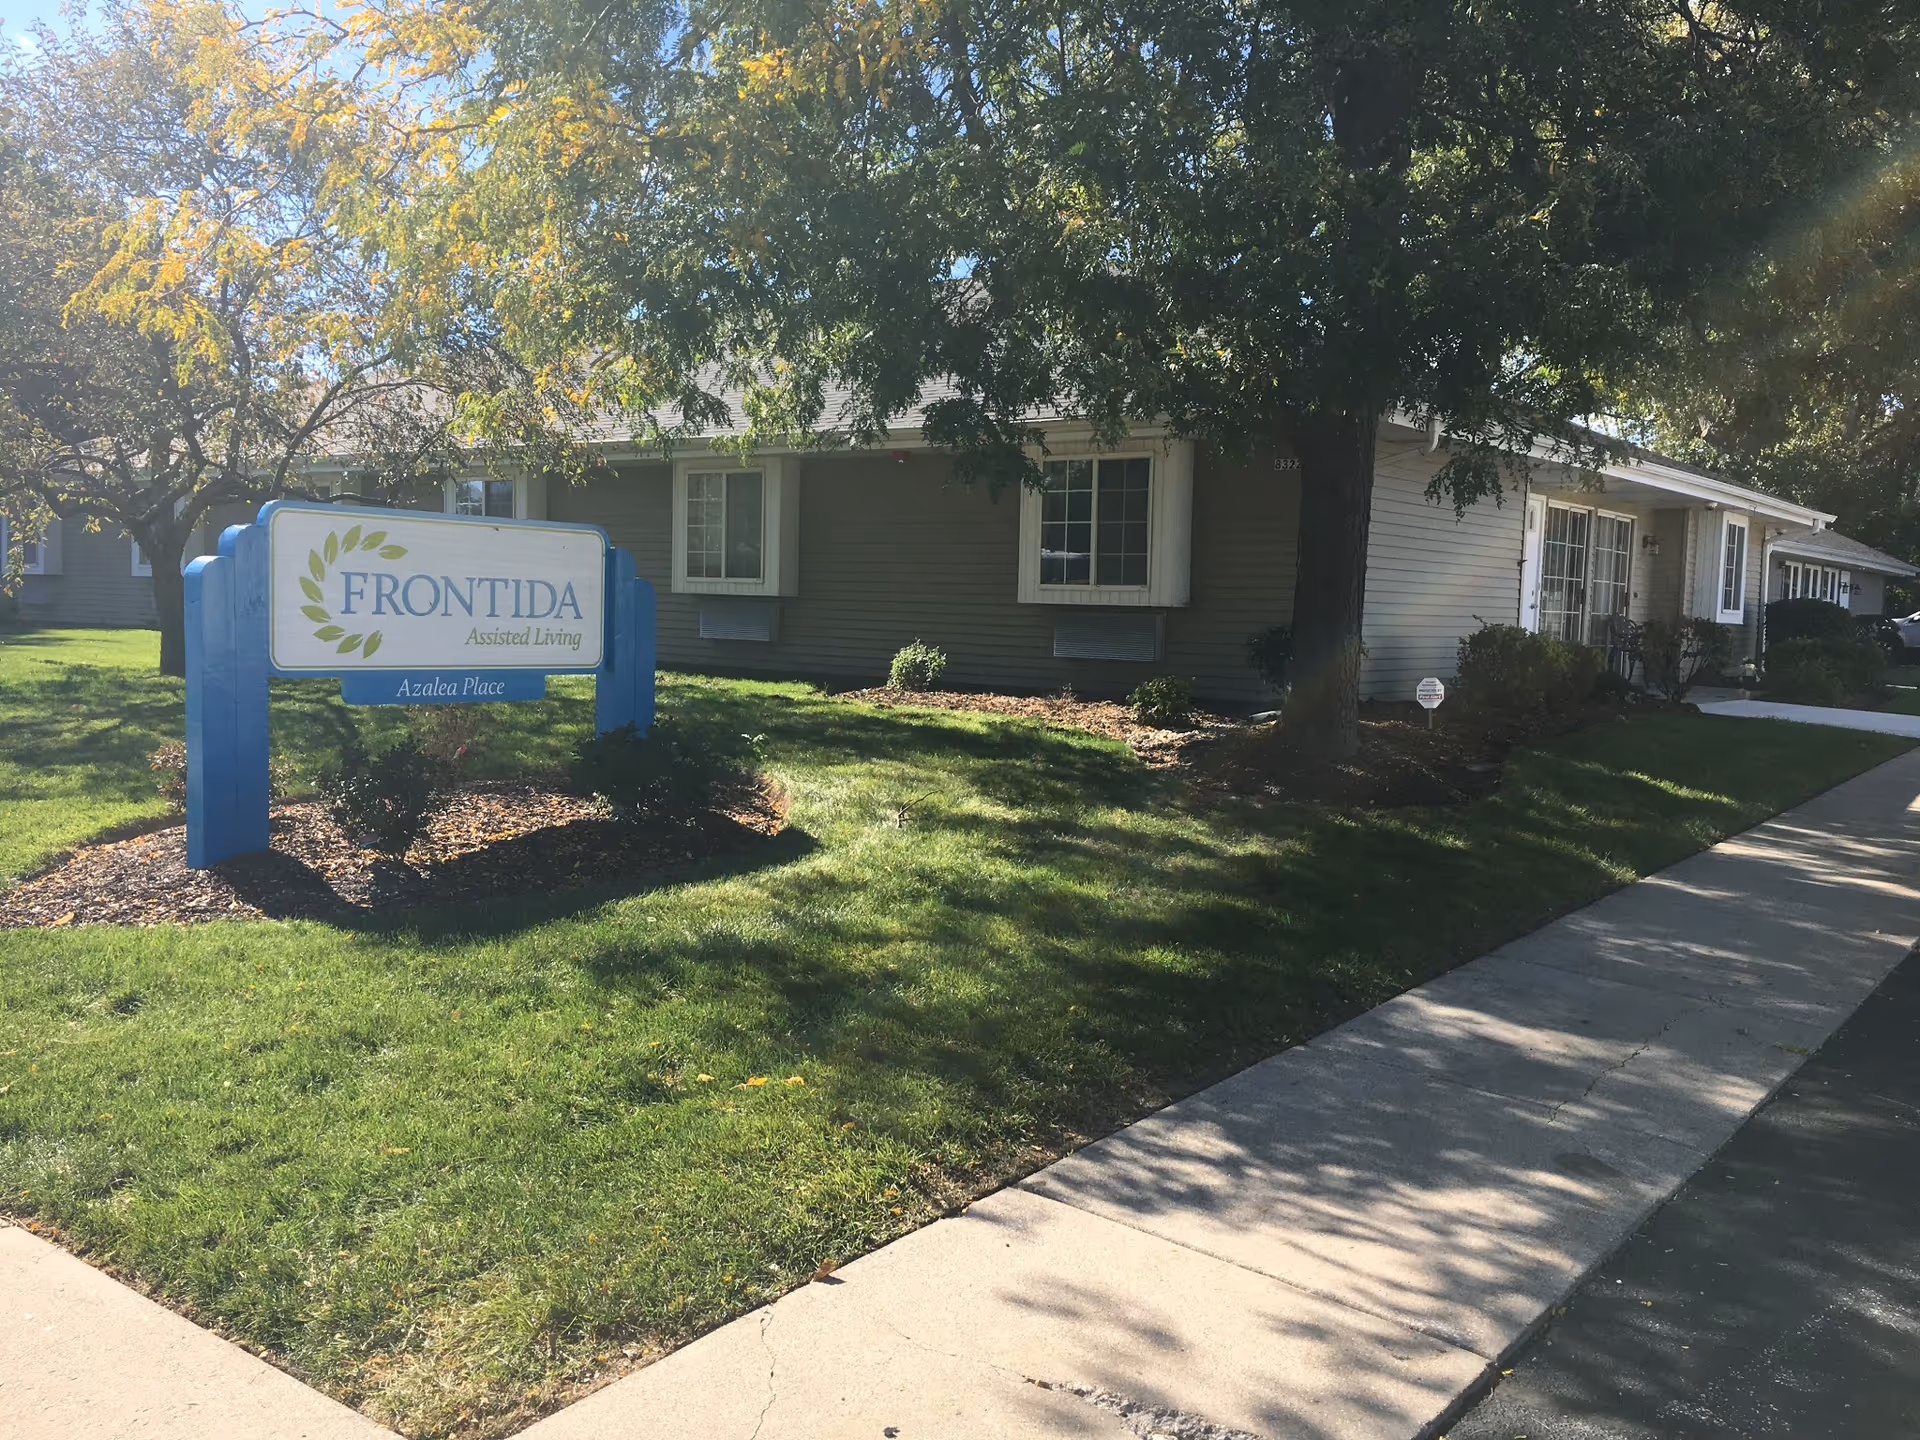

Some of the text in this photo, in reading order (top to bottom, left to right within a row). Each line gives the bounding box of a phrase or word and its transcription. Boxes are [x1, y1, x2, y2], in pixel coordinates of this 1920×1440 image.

[340, 571, 583, 619] FRONTIDA
[464, 626, 583, 651] Assisted Living
[396, 676, 506, 697] Azalea Place
